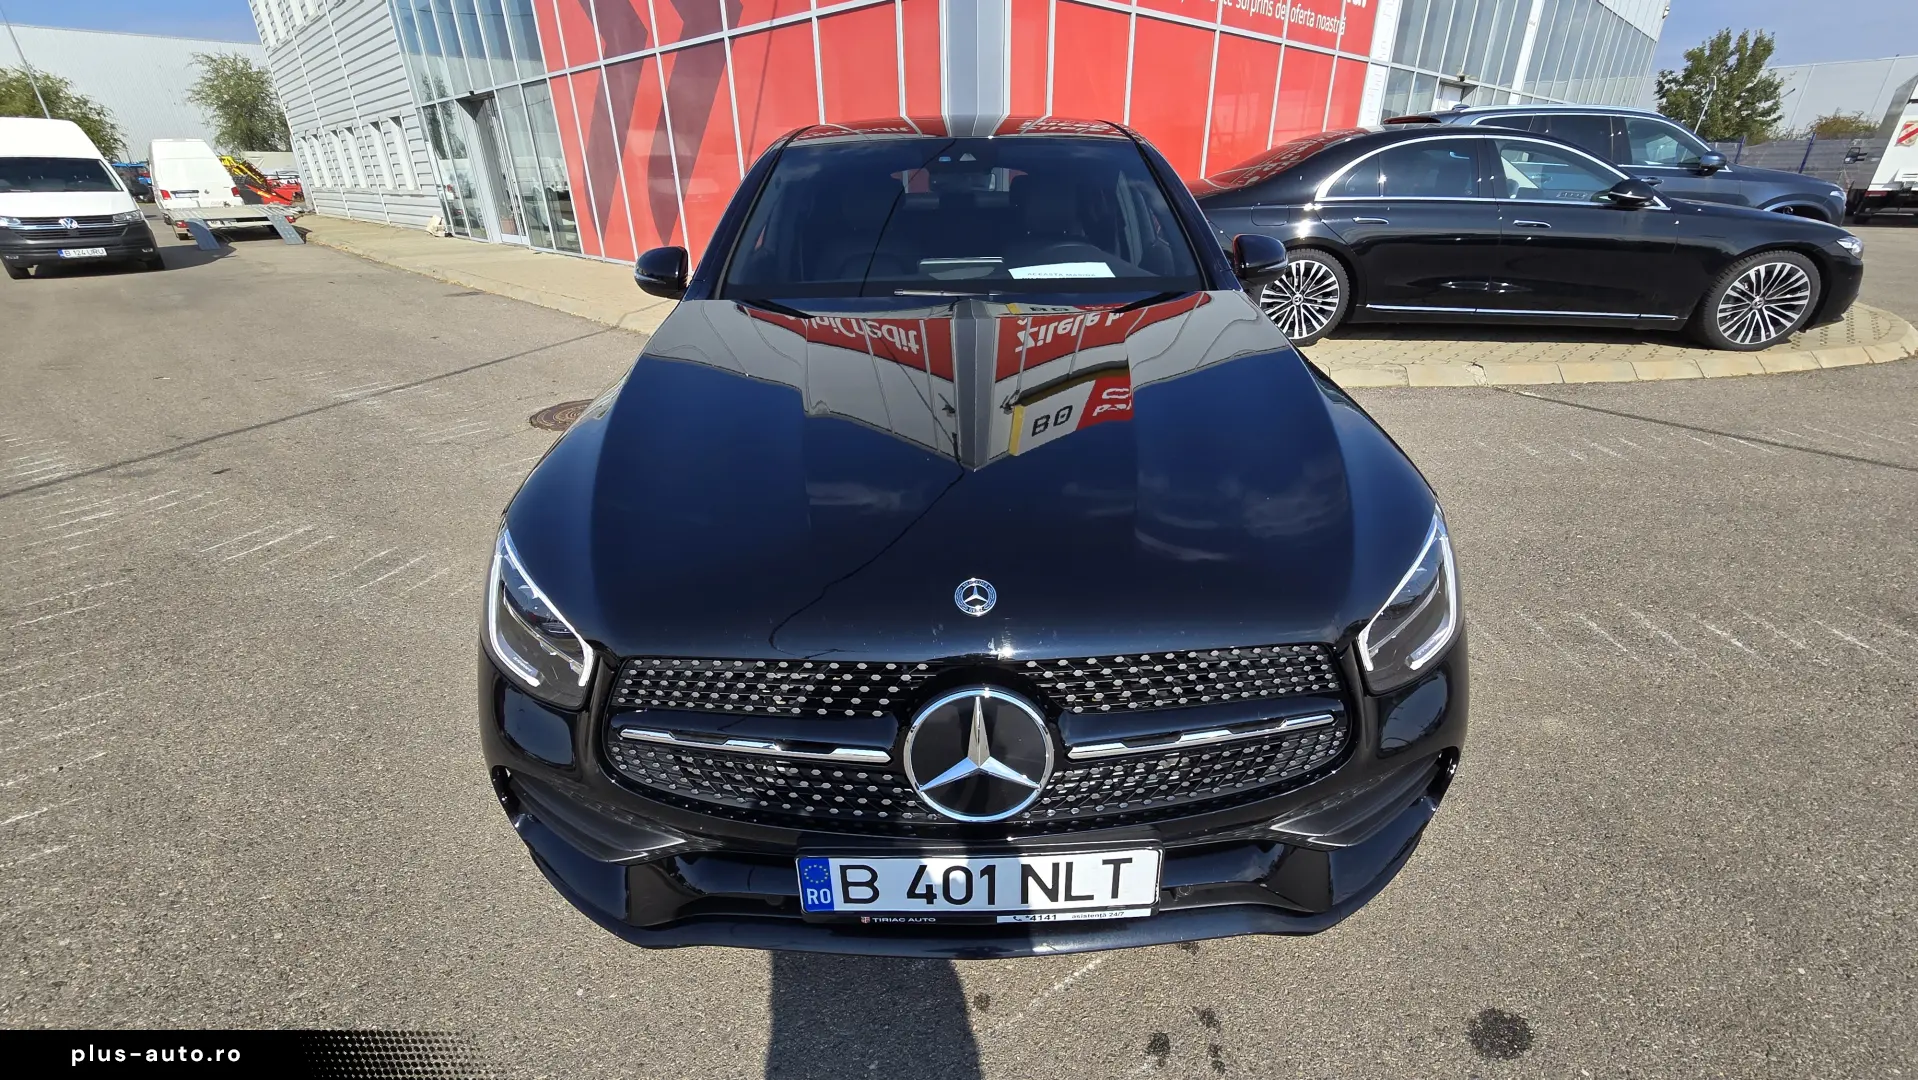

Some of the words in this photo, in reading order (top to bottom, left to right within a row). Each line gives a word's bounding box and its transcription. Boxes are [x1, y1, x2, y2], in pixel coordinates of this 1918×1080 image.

[1275, 0, 1286, 20] de
[1290, 3, 1315, 28] oferta
[839, 864, 880, 904] B
[906, 864, 997, 905] 401
[1020, 857, 1133, 905] NLT
[806, 888, 831, 905] RO
